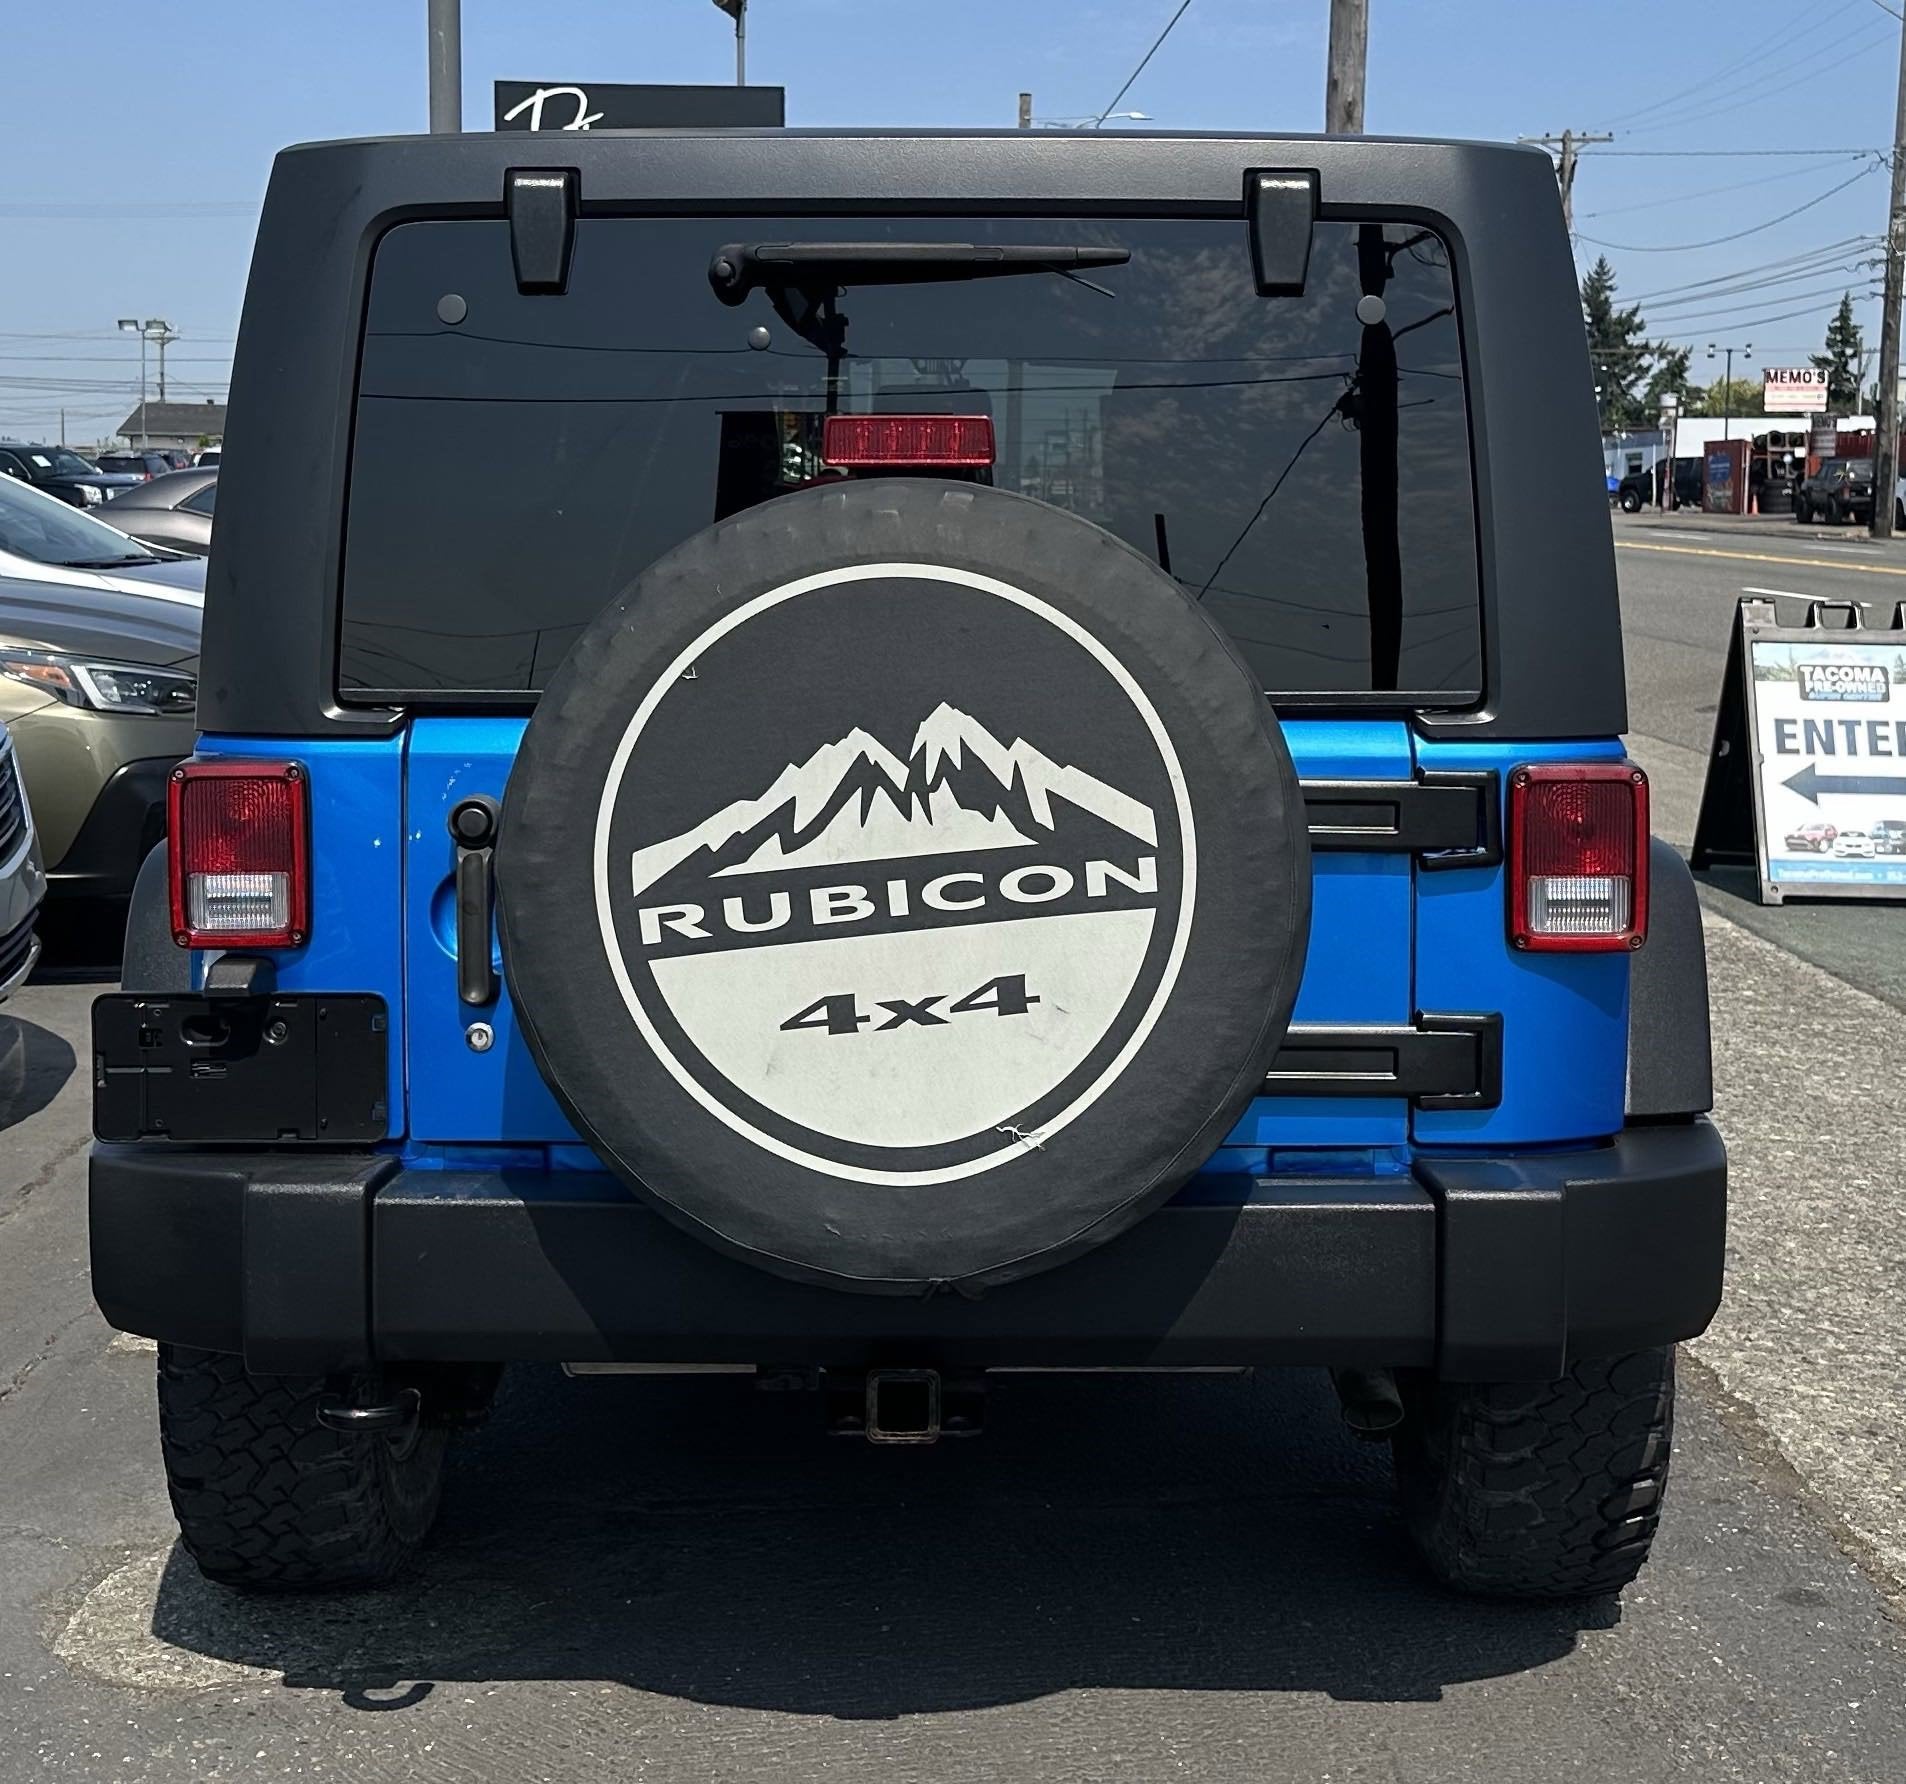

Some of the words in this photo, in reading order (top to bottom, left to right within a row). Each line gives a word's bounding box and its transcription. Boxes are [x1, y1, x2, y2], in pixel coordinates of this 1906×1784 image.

[1765, 370, 1826, 384] MEMO'S
[1799, 665, 1885, 682] TACOMA
[1804, 680, 1887, 693] PRE-OWNED
[1774, 717, 1906, 757] ENTE
[638, 856, 1159, 945] RUBICON
[779, 973, 1041, 1036] 4x4
